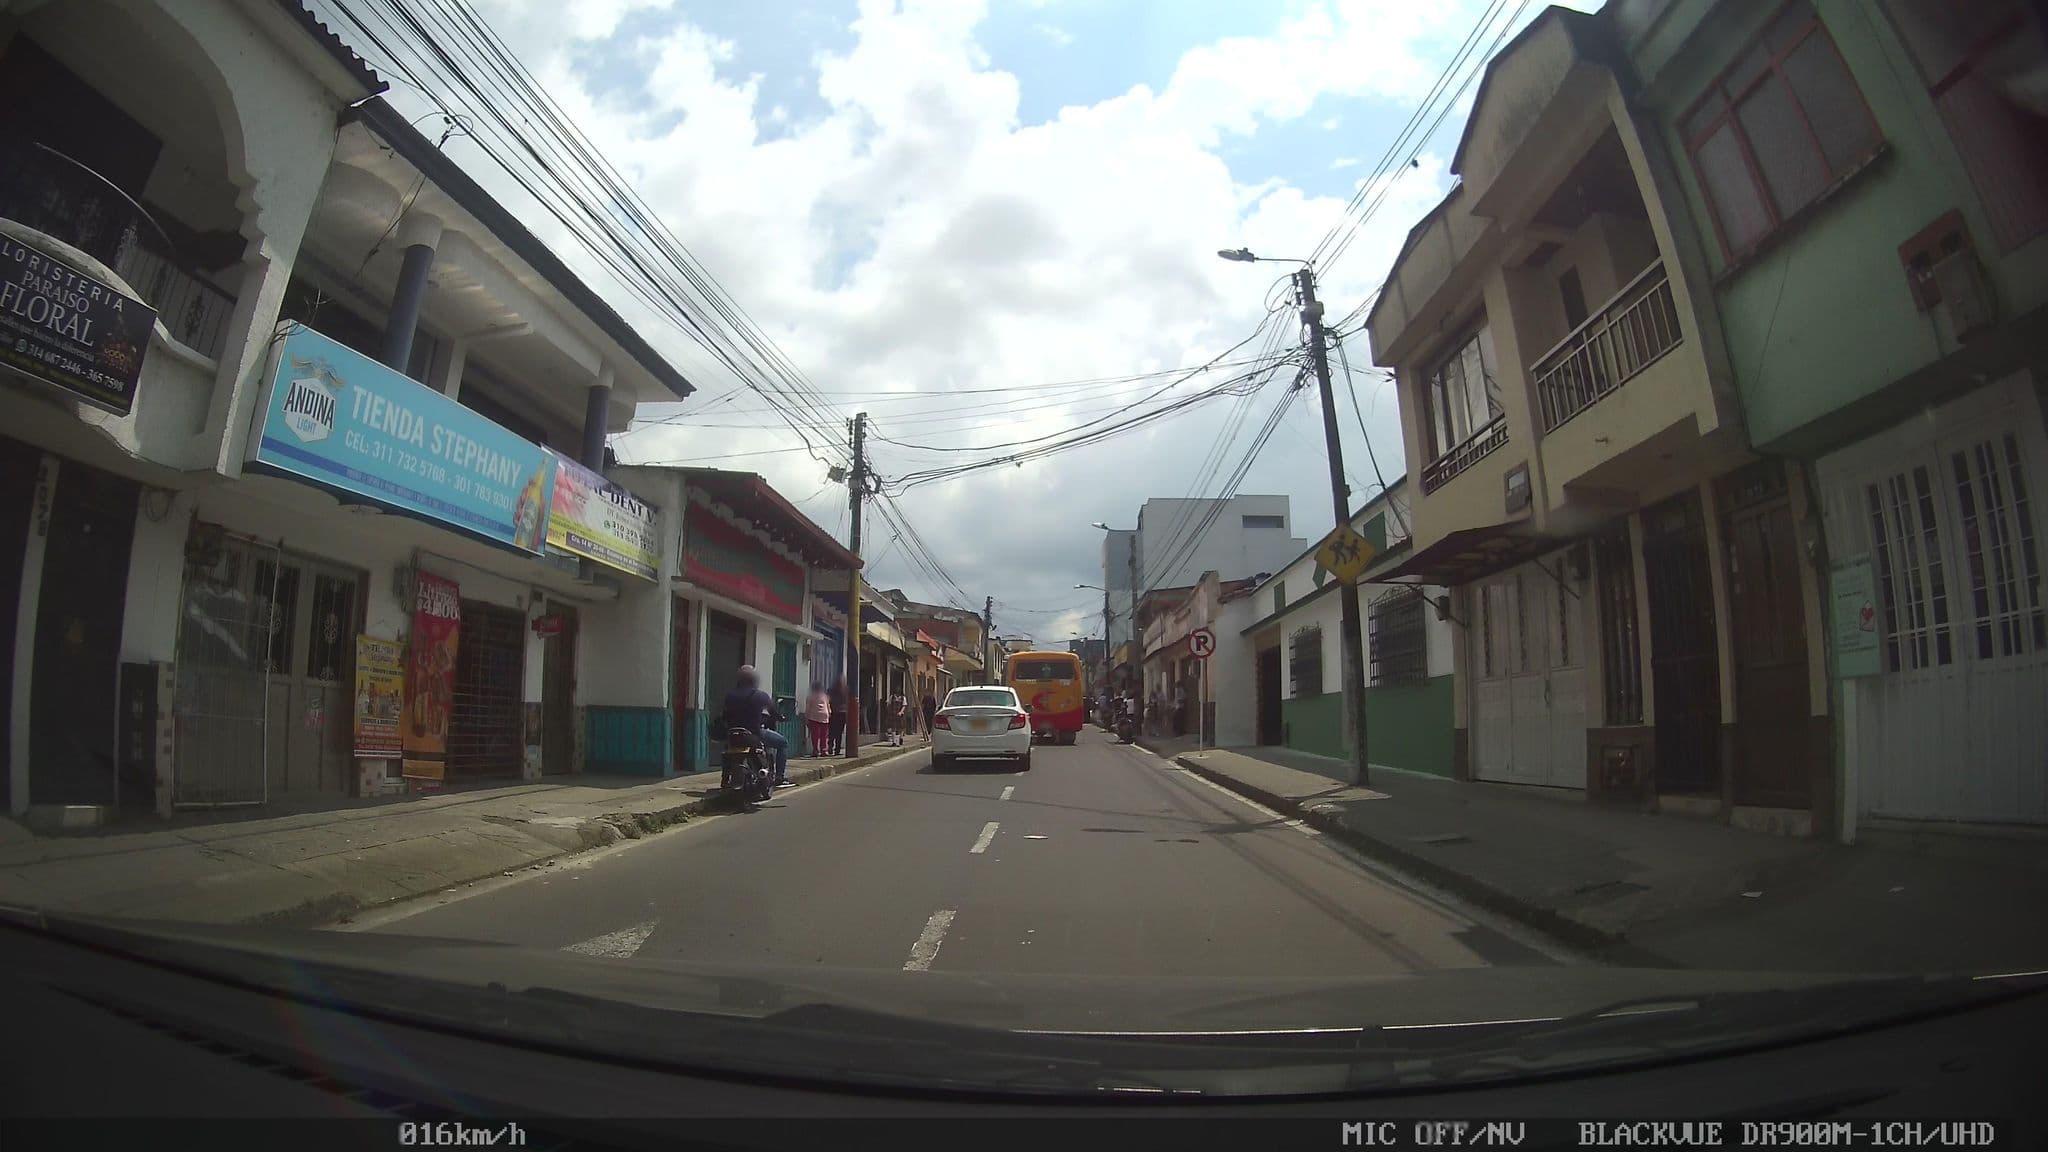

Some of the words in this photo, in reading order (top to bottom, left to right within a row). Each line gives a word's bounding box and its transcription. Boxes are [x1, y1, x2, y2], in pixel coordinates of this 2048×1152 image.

[0, 280, 94, 347] FLORAL
[21, 270, 90, 313] PARAISO
[283, 382, 335, 430] ANDINA
[296, 416, 318, 436] LIGHT
[351, 385, 425, 449] TIENDA
[430, 423, 523, 489] STEPHANY
[372, 441, 393, 462] 311
[397, 448, 417, 473] 732
[453, 474, 472, 493] 301
